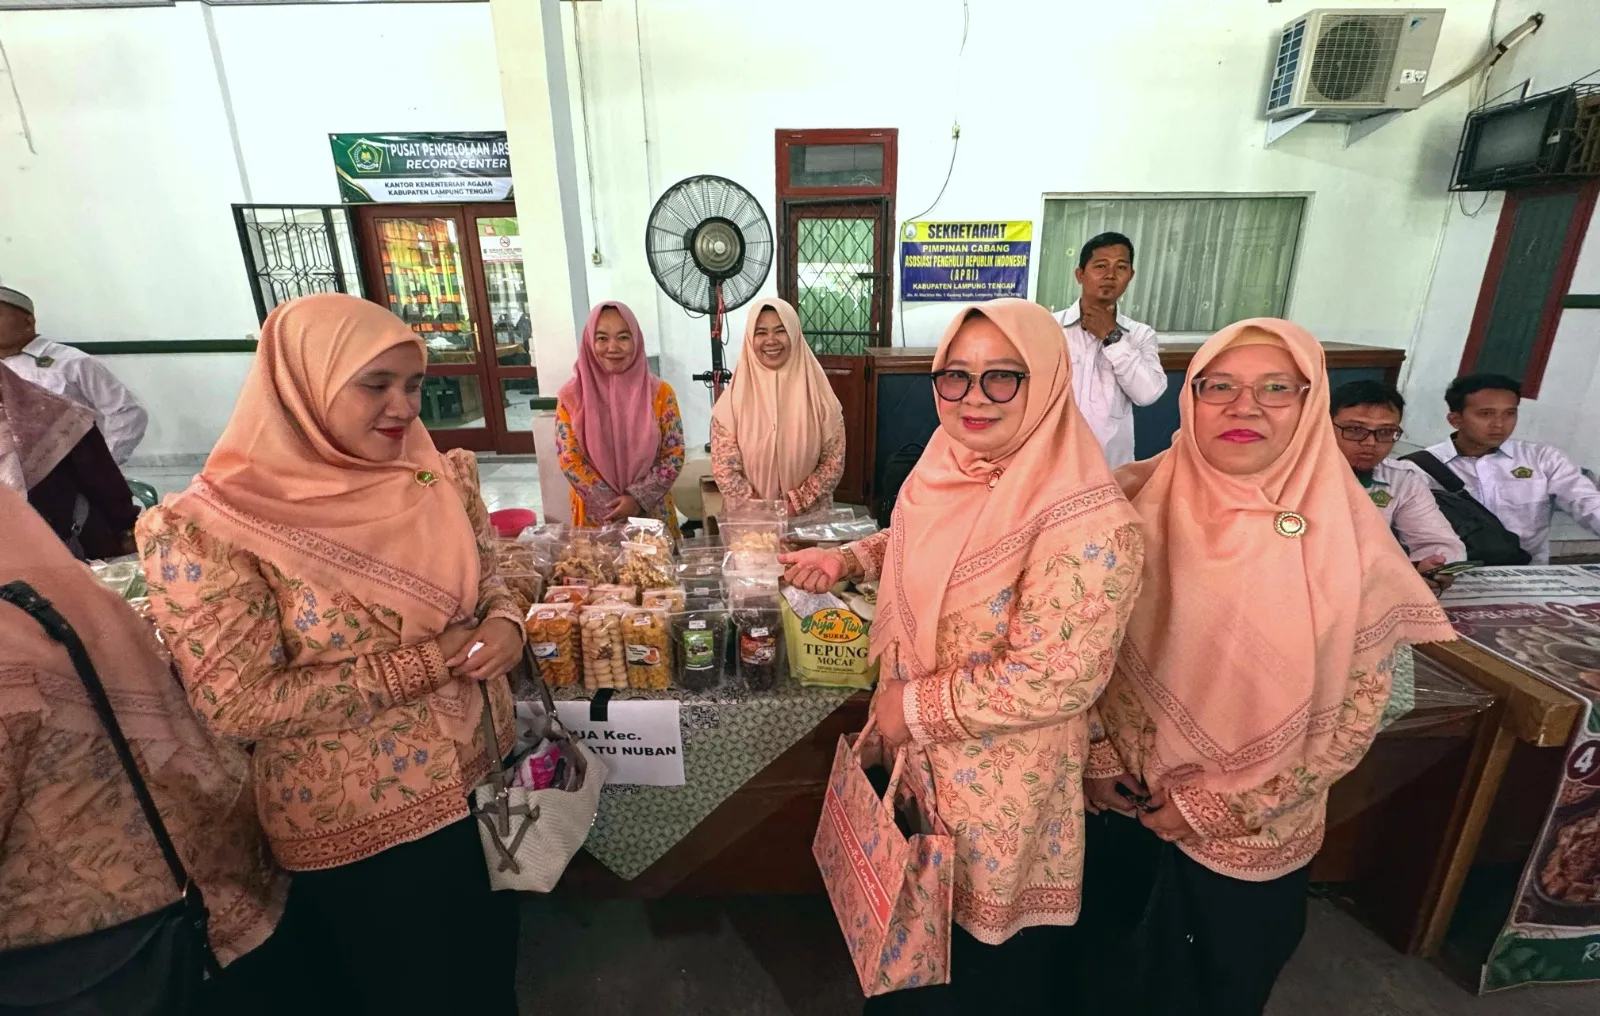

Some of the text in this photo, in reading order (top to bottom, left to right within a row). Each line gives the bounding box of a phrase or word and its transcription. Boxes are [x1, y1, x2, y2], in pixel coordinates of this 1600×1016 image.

[391, 142, 510, 157] PUSAT PENGELOLAAN ARS
[406, 158, 508, 169] RECORD CENTER
[927, 223, 1008, 239] SEKRETARIAT
[922, 244, 1010, 253] PIMPINAN CABANG
[904, 254, 1027, 267] ASOSIASI PENGHULU REPUBLIK INDONESIA
[953, 282, 987, 290] LAMPUNG
[988, 282, 1016, 290] TENGAH
[803, 643, 868, 659] TEPUNG
[817, 657, 855, 667] MOCAF
[603, 730, 642, 741] Kec.
[588, 746, 677, 756] ATU NUBAN
[1573, 746, 1597, 773] 4
